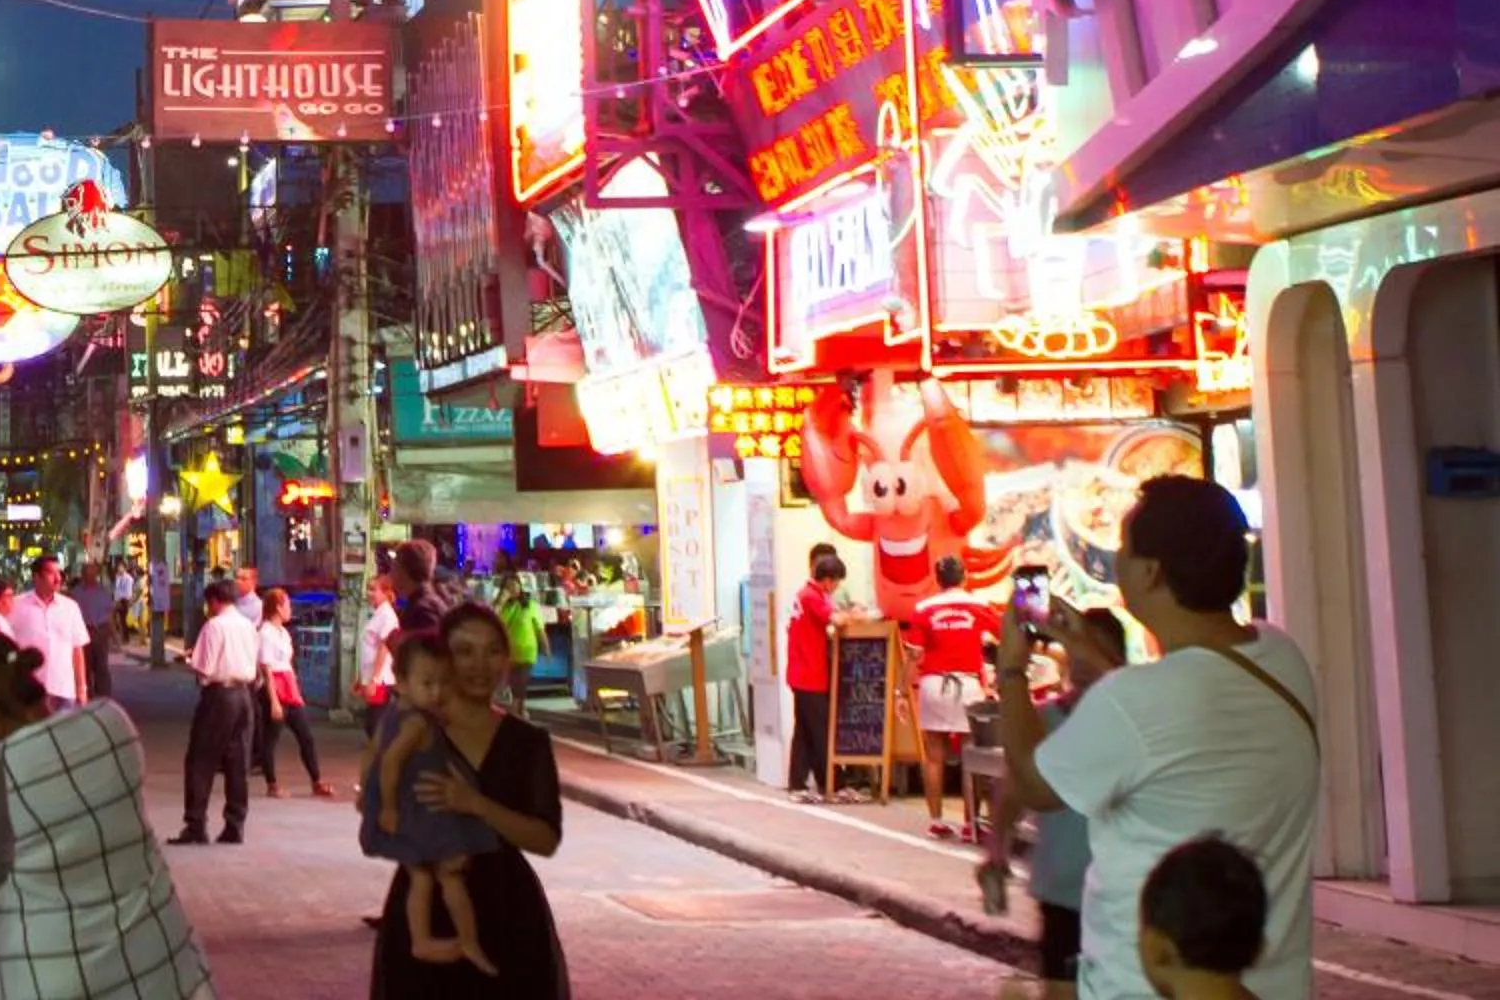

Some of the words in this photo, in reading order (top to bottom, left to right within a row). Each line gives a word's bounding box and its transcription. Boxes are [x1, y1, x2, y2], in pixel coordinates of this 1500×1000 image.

[161, 46, 218, 60] THE
[162, 62, 384, 99] LIGHTHOUSE
[297, 102, 339, 116] GO
[343, 102, 384, 116] GO
[23, 235, 158, 275] SIMON
